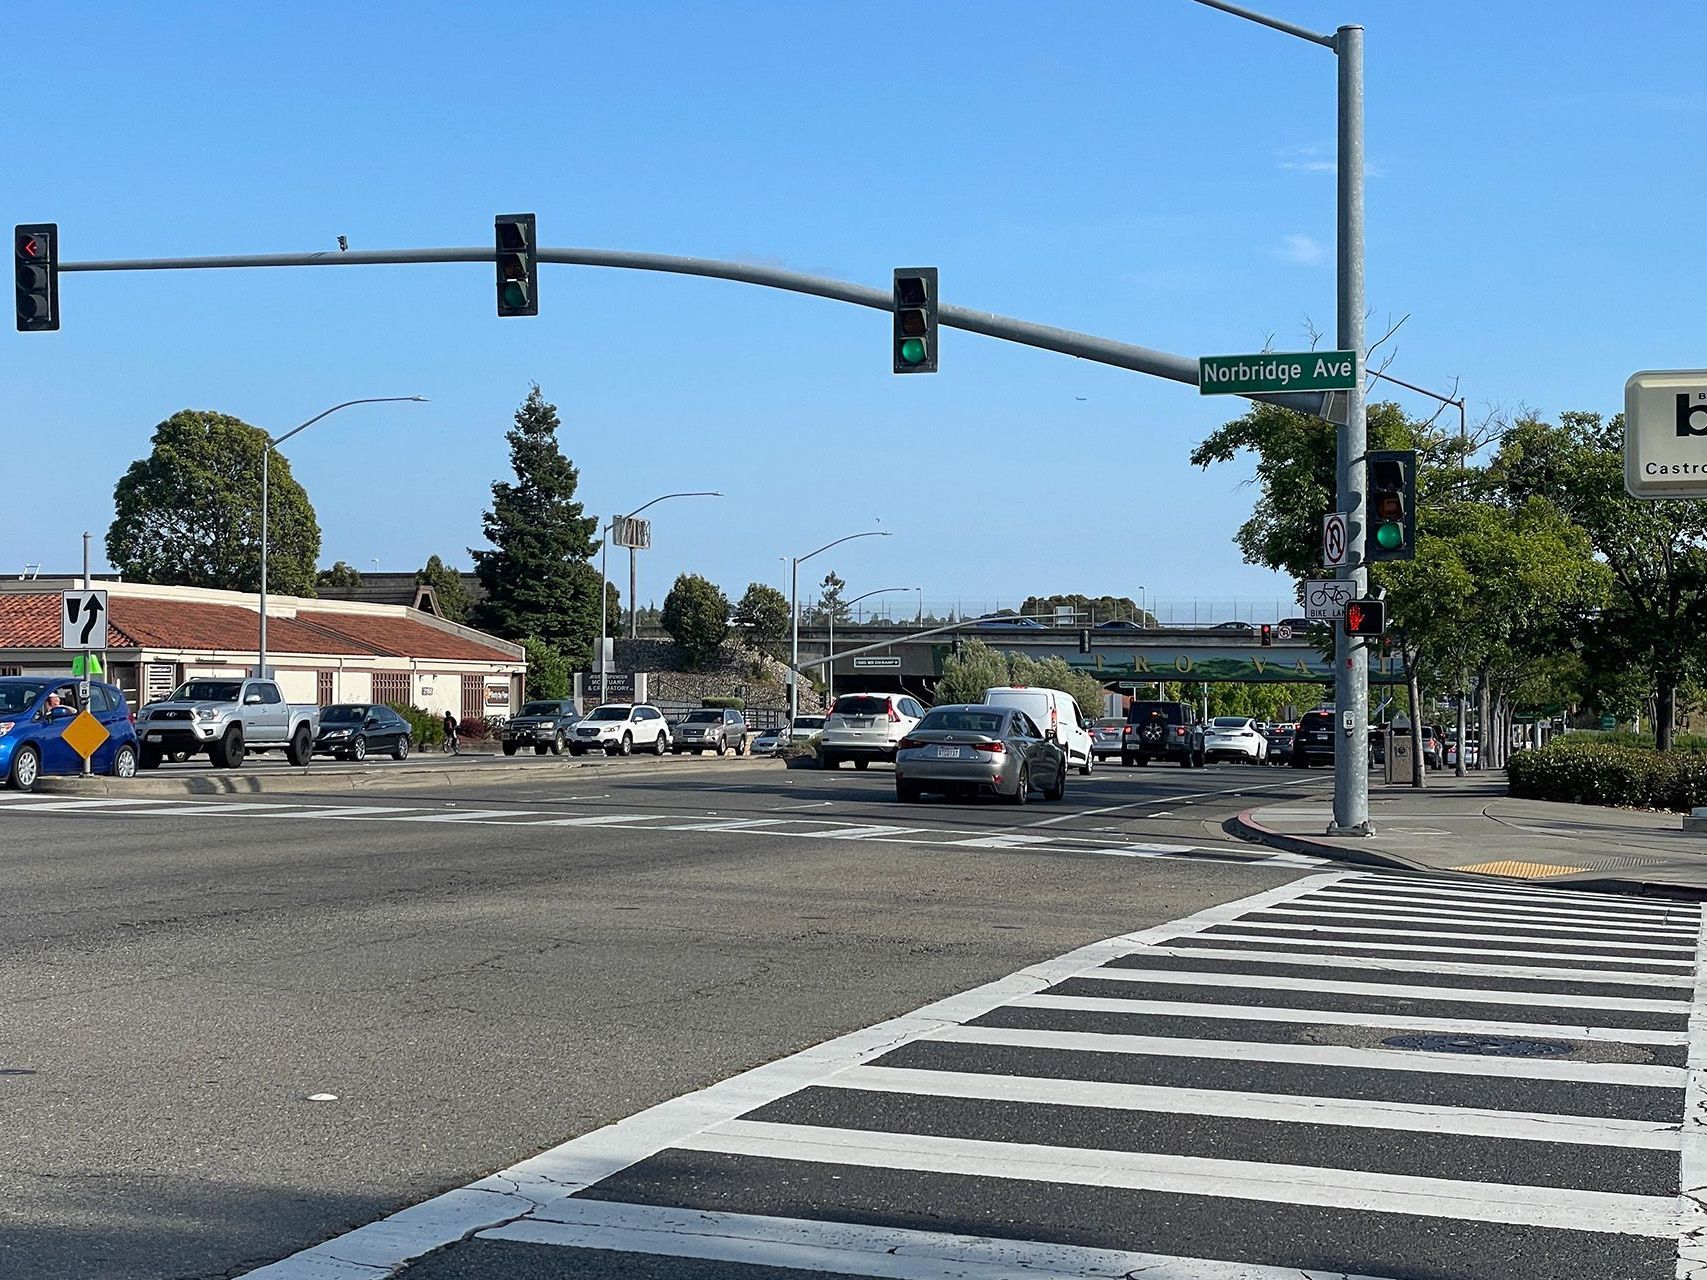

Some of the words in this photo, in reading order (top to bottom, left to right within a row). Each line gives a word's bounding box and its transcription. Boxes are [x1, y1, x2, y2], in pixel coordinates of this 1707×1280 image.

[1204, 360, 1302, 385] Norbridge
[1312, 358, 1352, 378] Ave
[1310, 609, 1327, 617] BIKE
[1332, 609, 1345, 617] LAN
